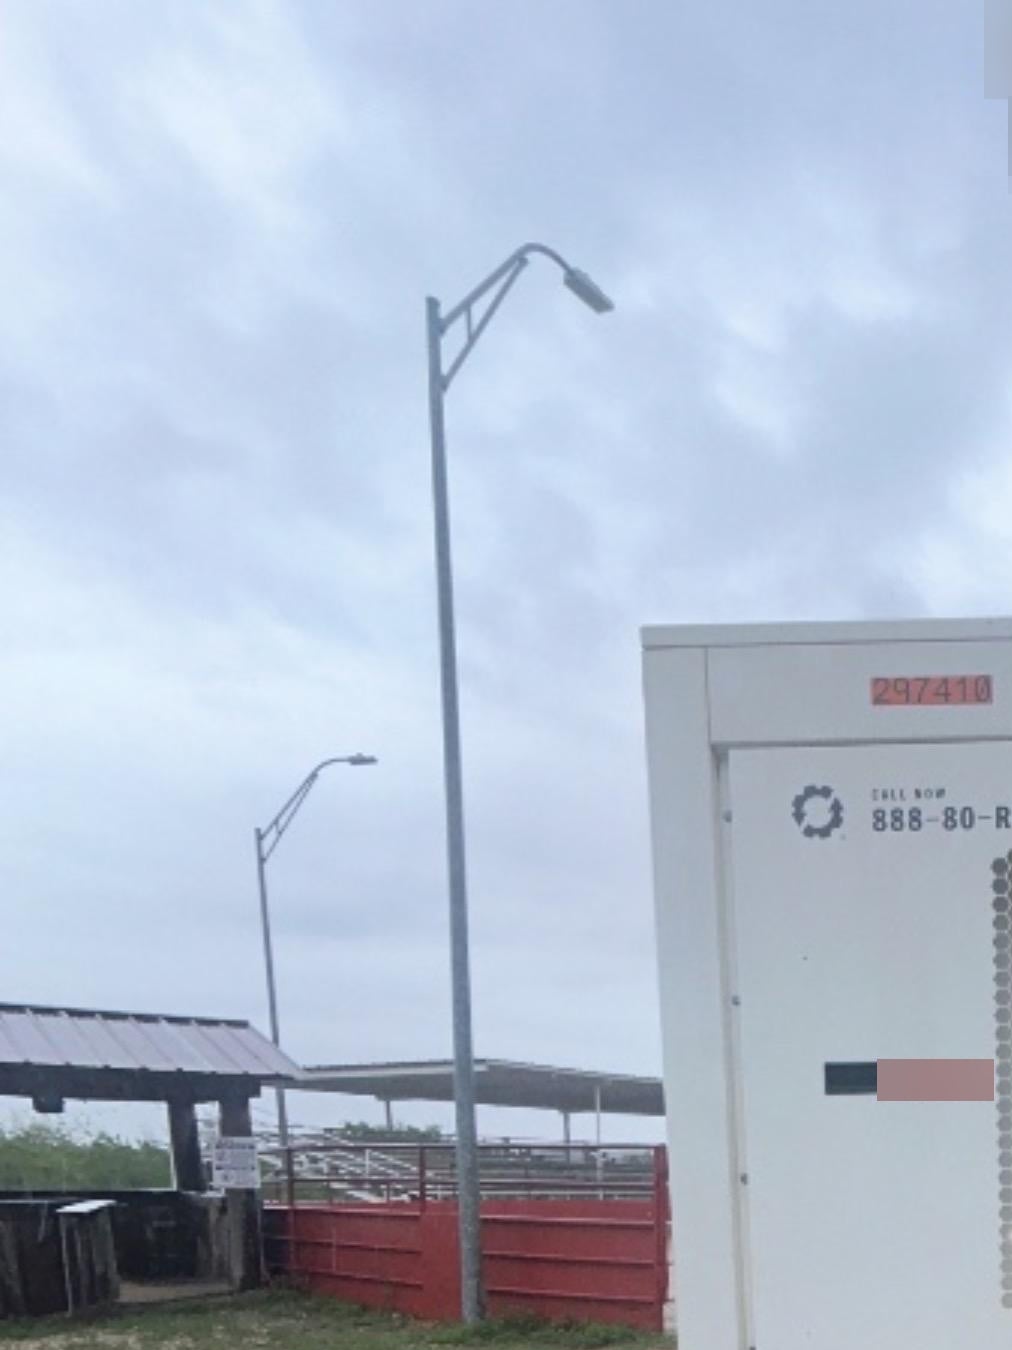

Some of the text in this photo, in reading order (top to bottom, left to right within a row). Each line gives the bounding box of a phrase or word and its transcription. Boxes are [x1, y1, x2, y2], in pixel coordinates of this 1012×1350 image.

[871, 676, 992, 705] 297410
[871, 787, 946, 802] CALL NOW
